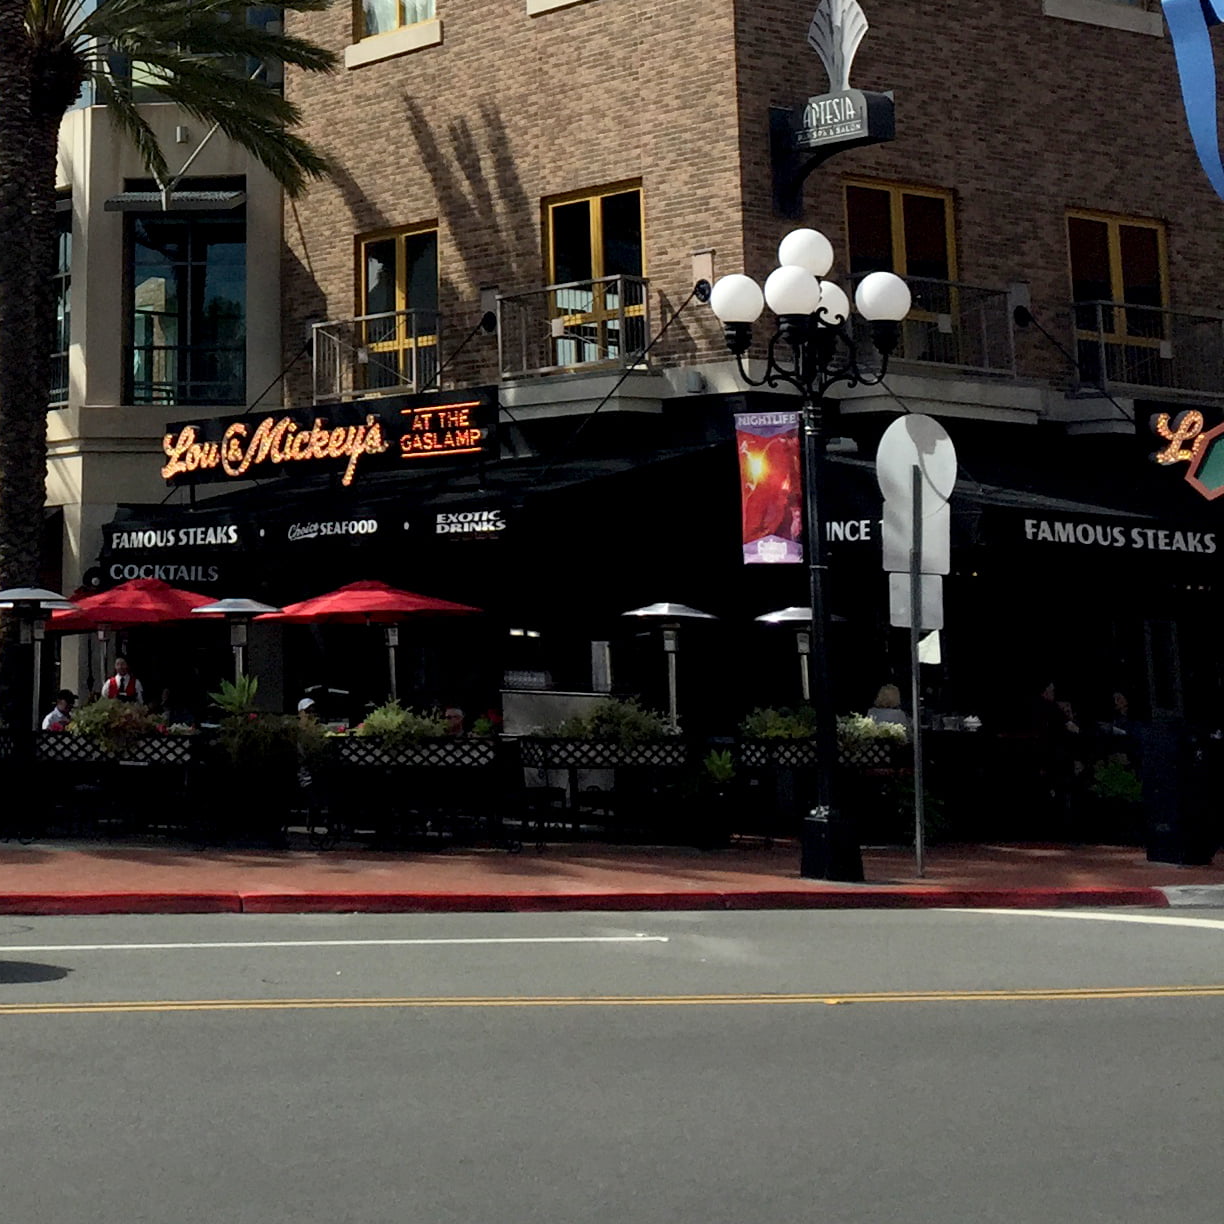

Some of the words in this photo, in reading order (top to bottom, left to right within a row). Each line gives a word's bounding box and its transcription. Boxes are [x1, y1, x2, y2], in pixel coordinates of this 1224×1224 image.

[412, 413, 430, 431] AT
[439, 409, 470, 427] THE
[737, 413, 797, 426] NIGHTLIFE
[161, 426, 221, 479] Lou
[222, 414, 390, 487] Mickey's
[399, 428, 482, 452] GASLAMP
[435, 520, 506, 534] DRINKS
[436, 510, 501, 524] EXOTIC
[111, 529, 176, 549] FAMOUS
[178, 525, 238, 546] STEAKS
[287, 523, 319, 541] Choice
[319, 519, 378, 536] SEAFOOD
[826, 520, 871, 542] INCE
[1024, 519, 1126, 547] FAMOUS
[1130, 528, 1216, 553] STEAKS
[109, 563, 219, 582] COCKTAILS
